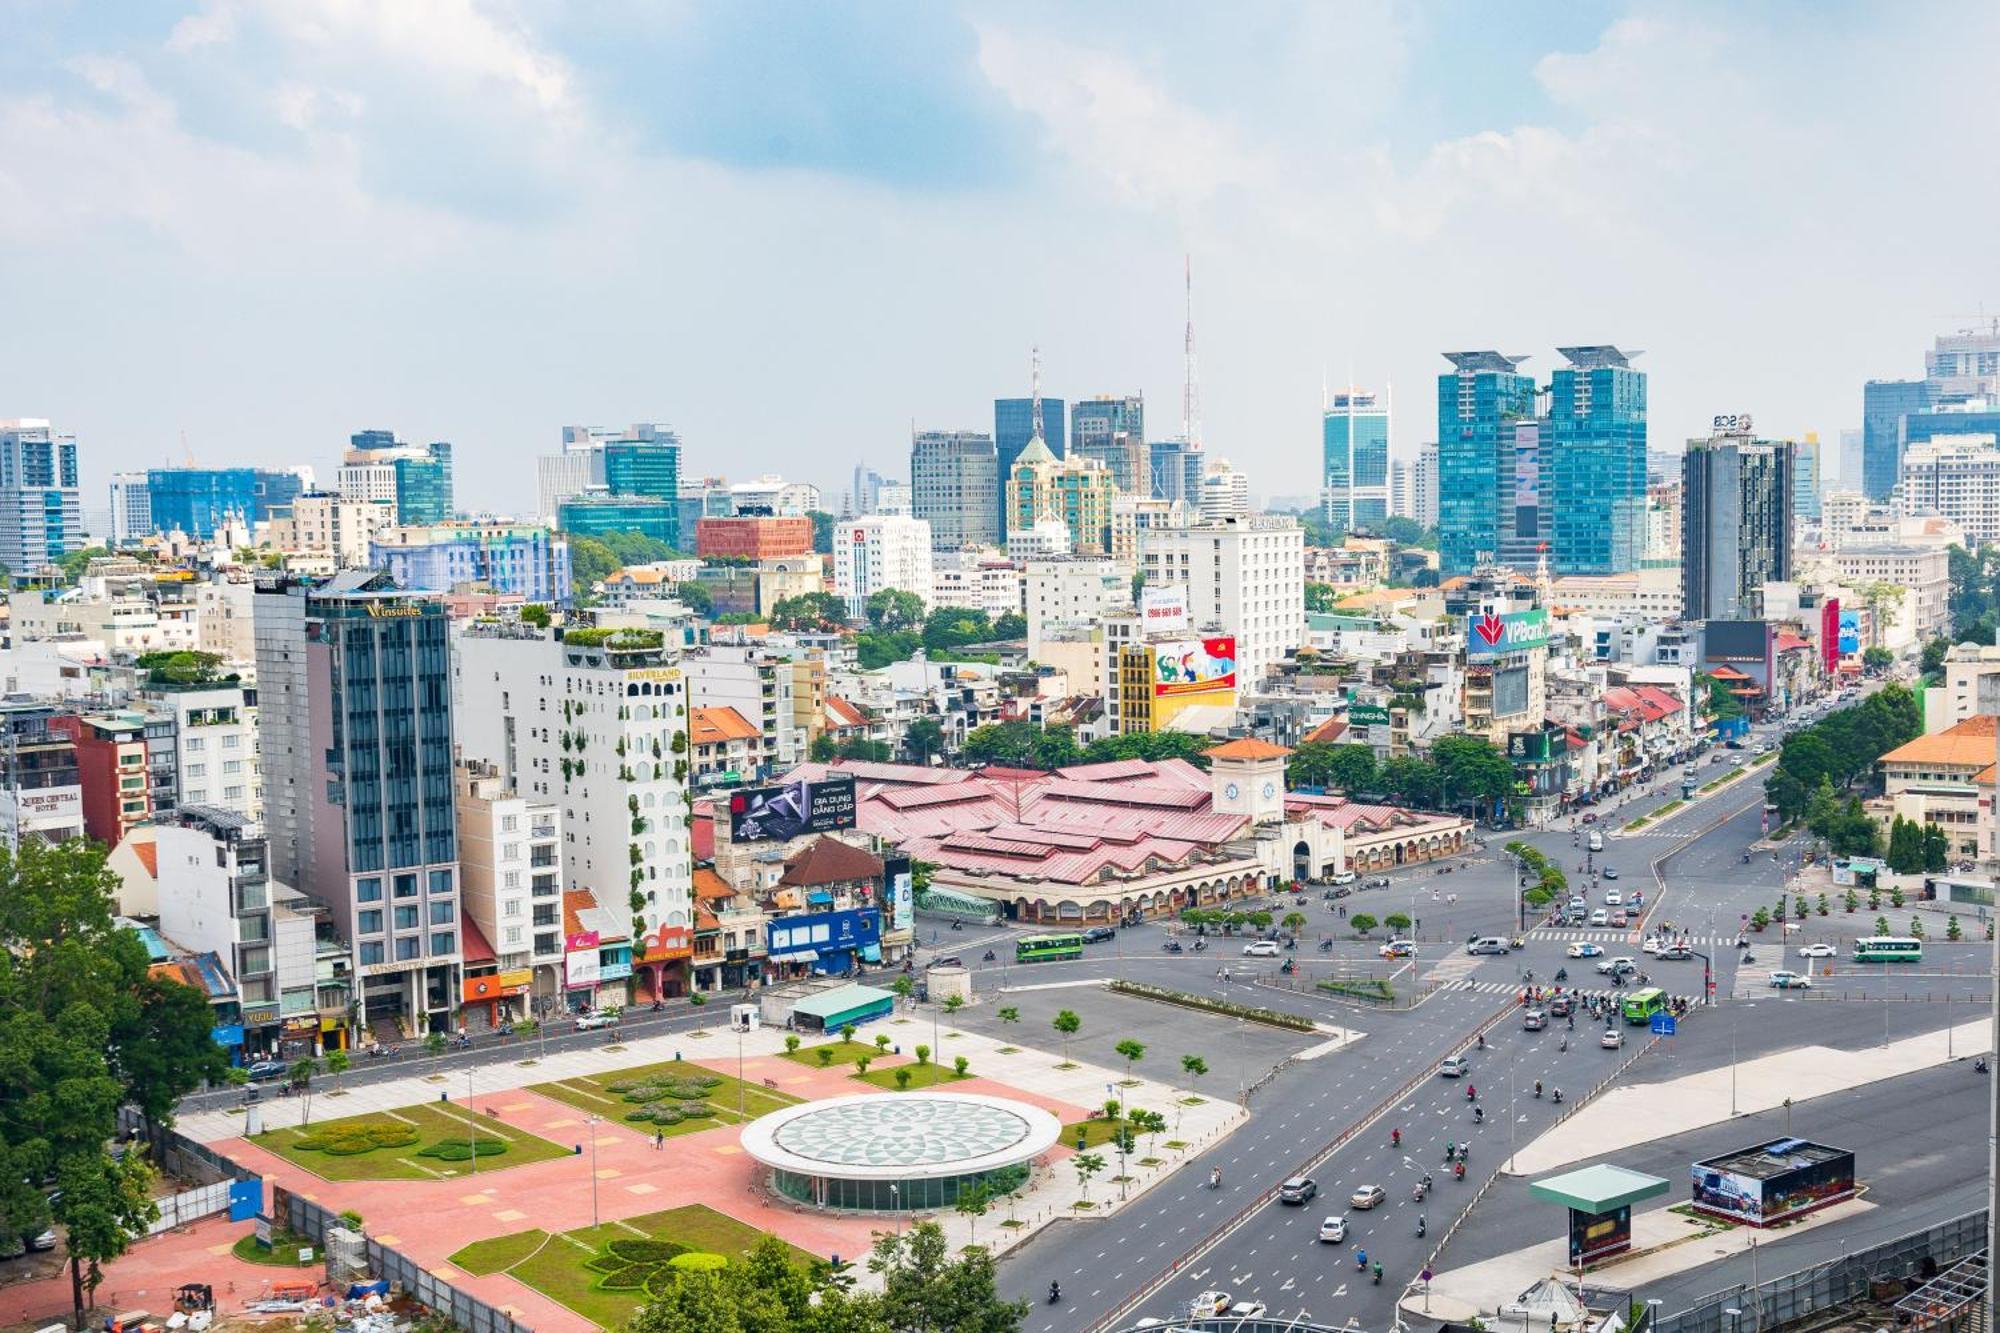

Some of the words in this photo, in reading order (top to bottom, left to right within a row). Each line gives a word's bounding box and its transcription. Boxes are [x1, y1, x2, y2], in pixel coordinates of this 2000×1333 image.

[366, 603, 422, 617] Winsuites
[1506, 619, 1548, 643] VPBank
[47, 793, 78, 803] CENTRAL
[814, 797, 828, 806] GIA
[35, 803, 58, 813] HOTEL
